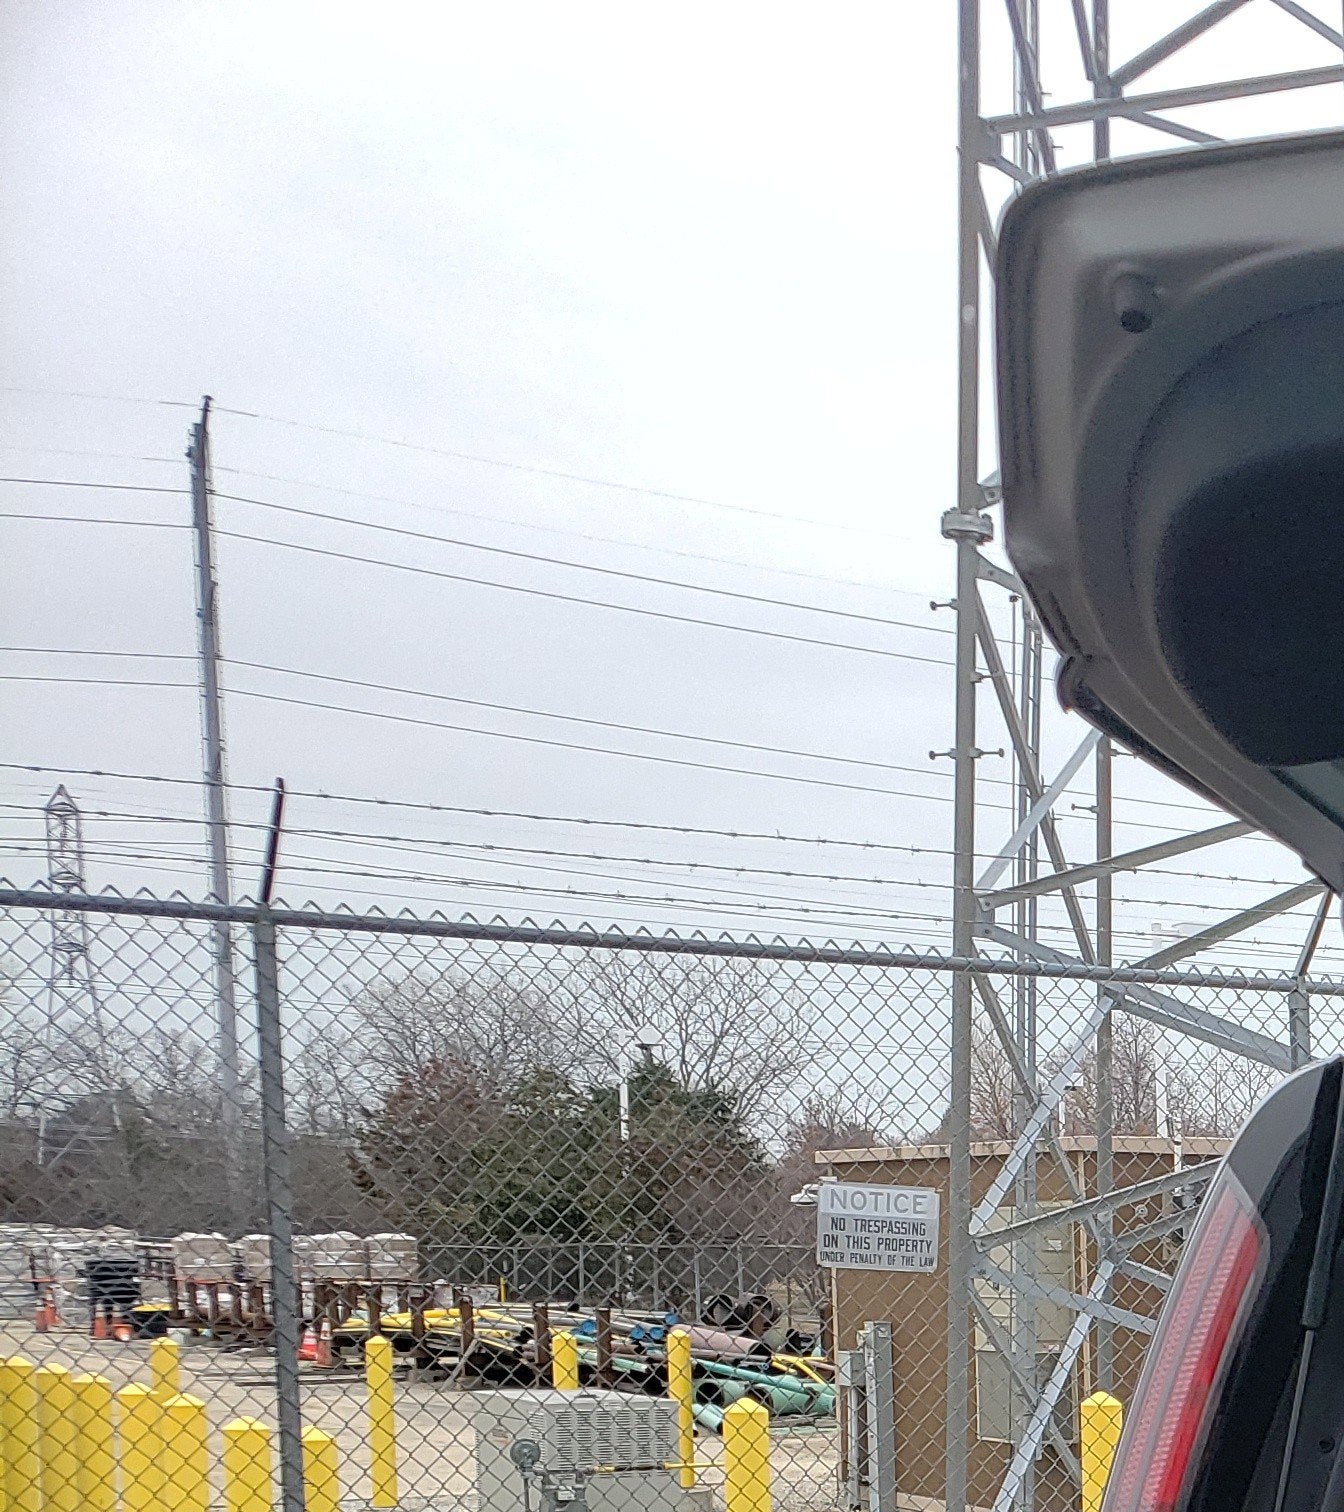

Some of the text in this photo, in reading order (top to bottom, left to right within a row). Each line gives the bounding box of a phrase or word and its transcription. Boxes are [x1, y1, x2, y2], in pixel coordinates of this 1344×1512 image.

[830, 1188, 928, 1215] NOTICE
[830, 1216, 927, 1236] NO TRESPASSING
[823, 1233, 933, 1254] ON THIS PROPERTY
[820, 1251, 935, 1268] UNDER PENALTY OF THE LAW
